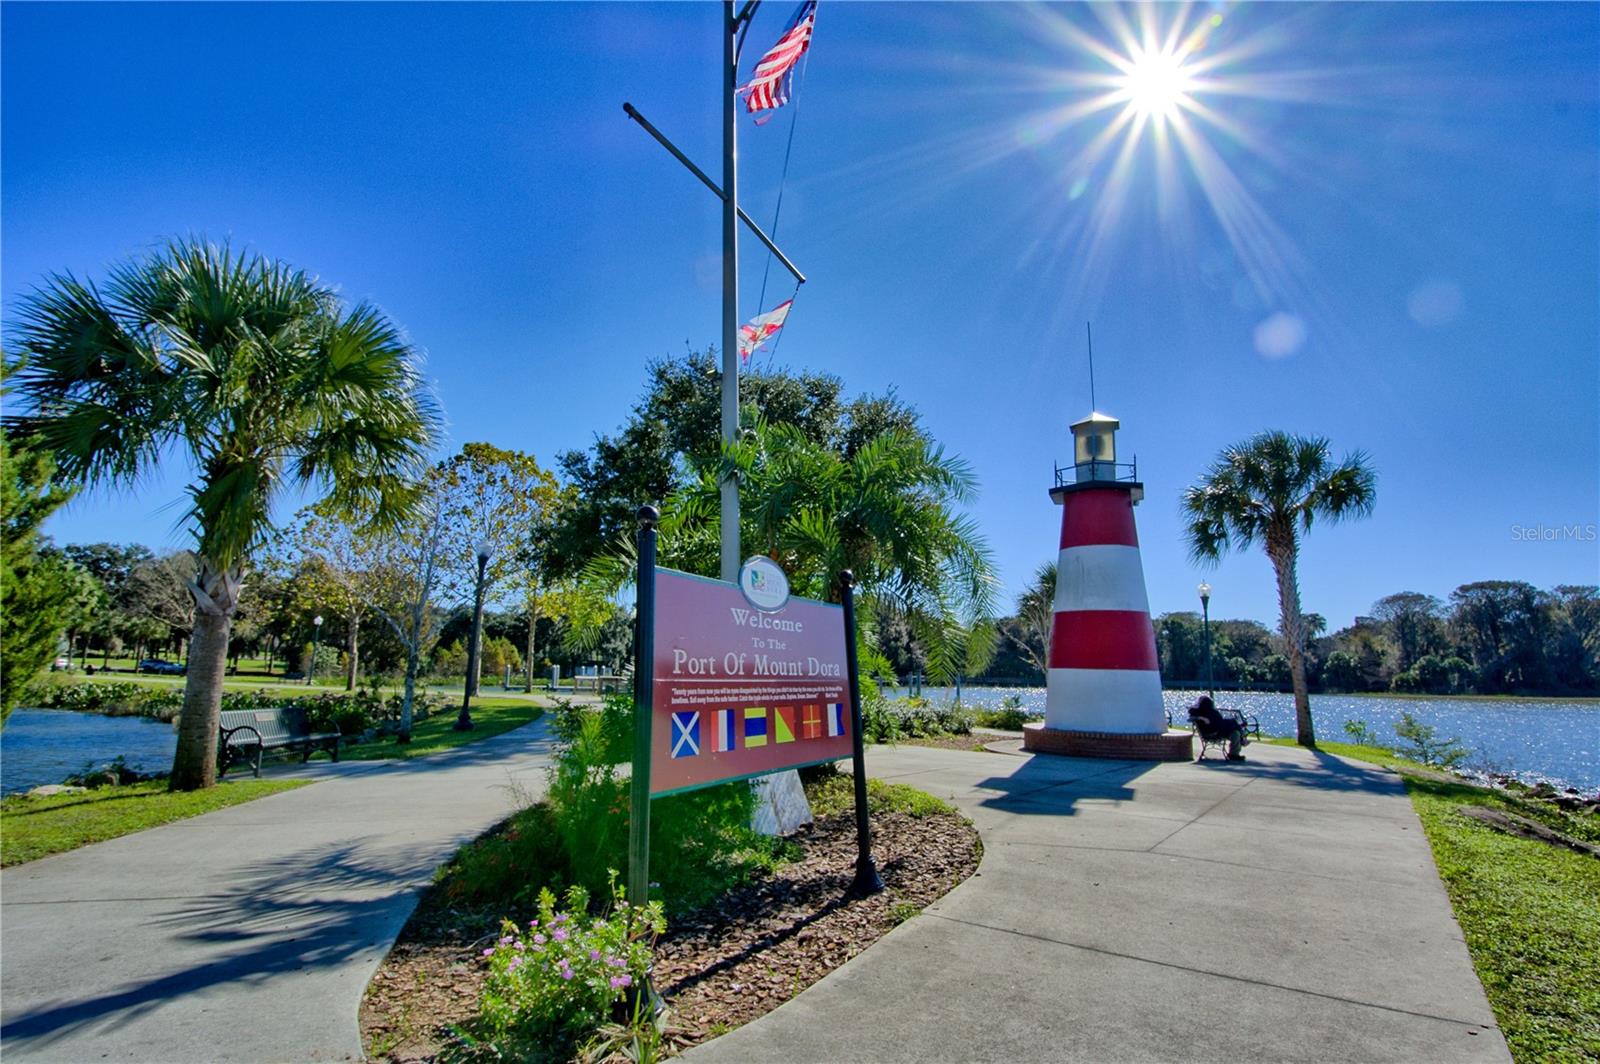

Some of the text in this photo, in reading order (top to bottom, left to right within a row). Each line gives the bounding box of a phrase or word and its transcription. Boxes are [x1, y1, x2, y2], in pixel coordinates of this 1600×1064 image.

[730, 607, 803, 632] Welcome
[752, 637, 786, 650] To The
[672, 649, 841, 677] Port Of Mount Dora
